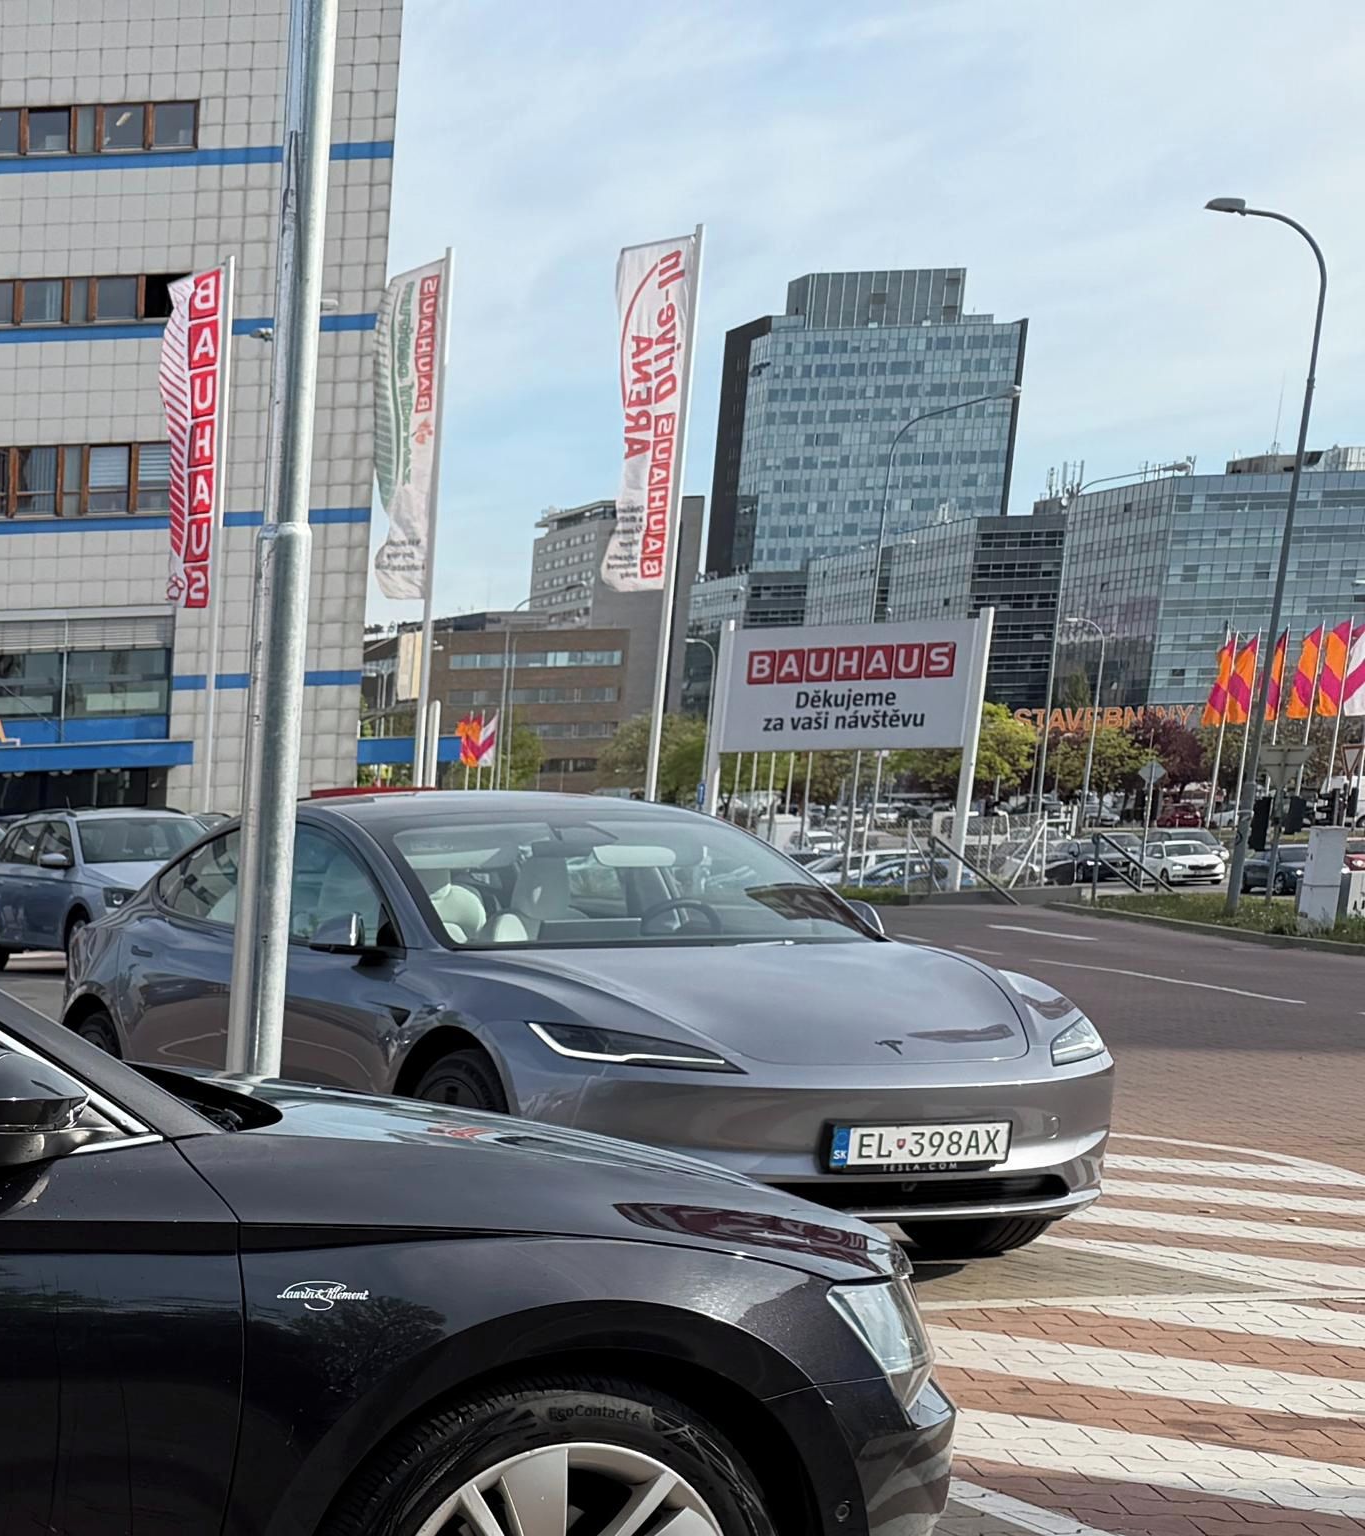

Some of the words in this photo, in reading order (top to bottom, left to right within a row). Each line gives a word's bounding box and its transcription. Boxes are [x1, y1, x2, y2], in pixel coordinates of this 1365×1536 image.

[751, 647, 950, 679] BAUHAUS
[795, 689, 896, 711] Děkujeme
[762, 717, 783, 732] za
[790, 712, 829, 731] vaši
[834, 709, 925, 730] návštěvu
[833, 1150, 847, 1160] SK
[857, 1133, 892, 1159] EL
[908, 1129, 1001, 1157] 398AX
[882, 1162, 958, 1172] TESLA.COM
